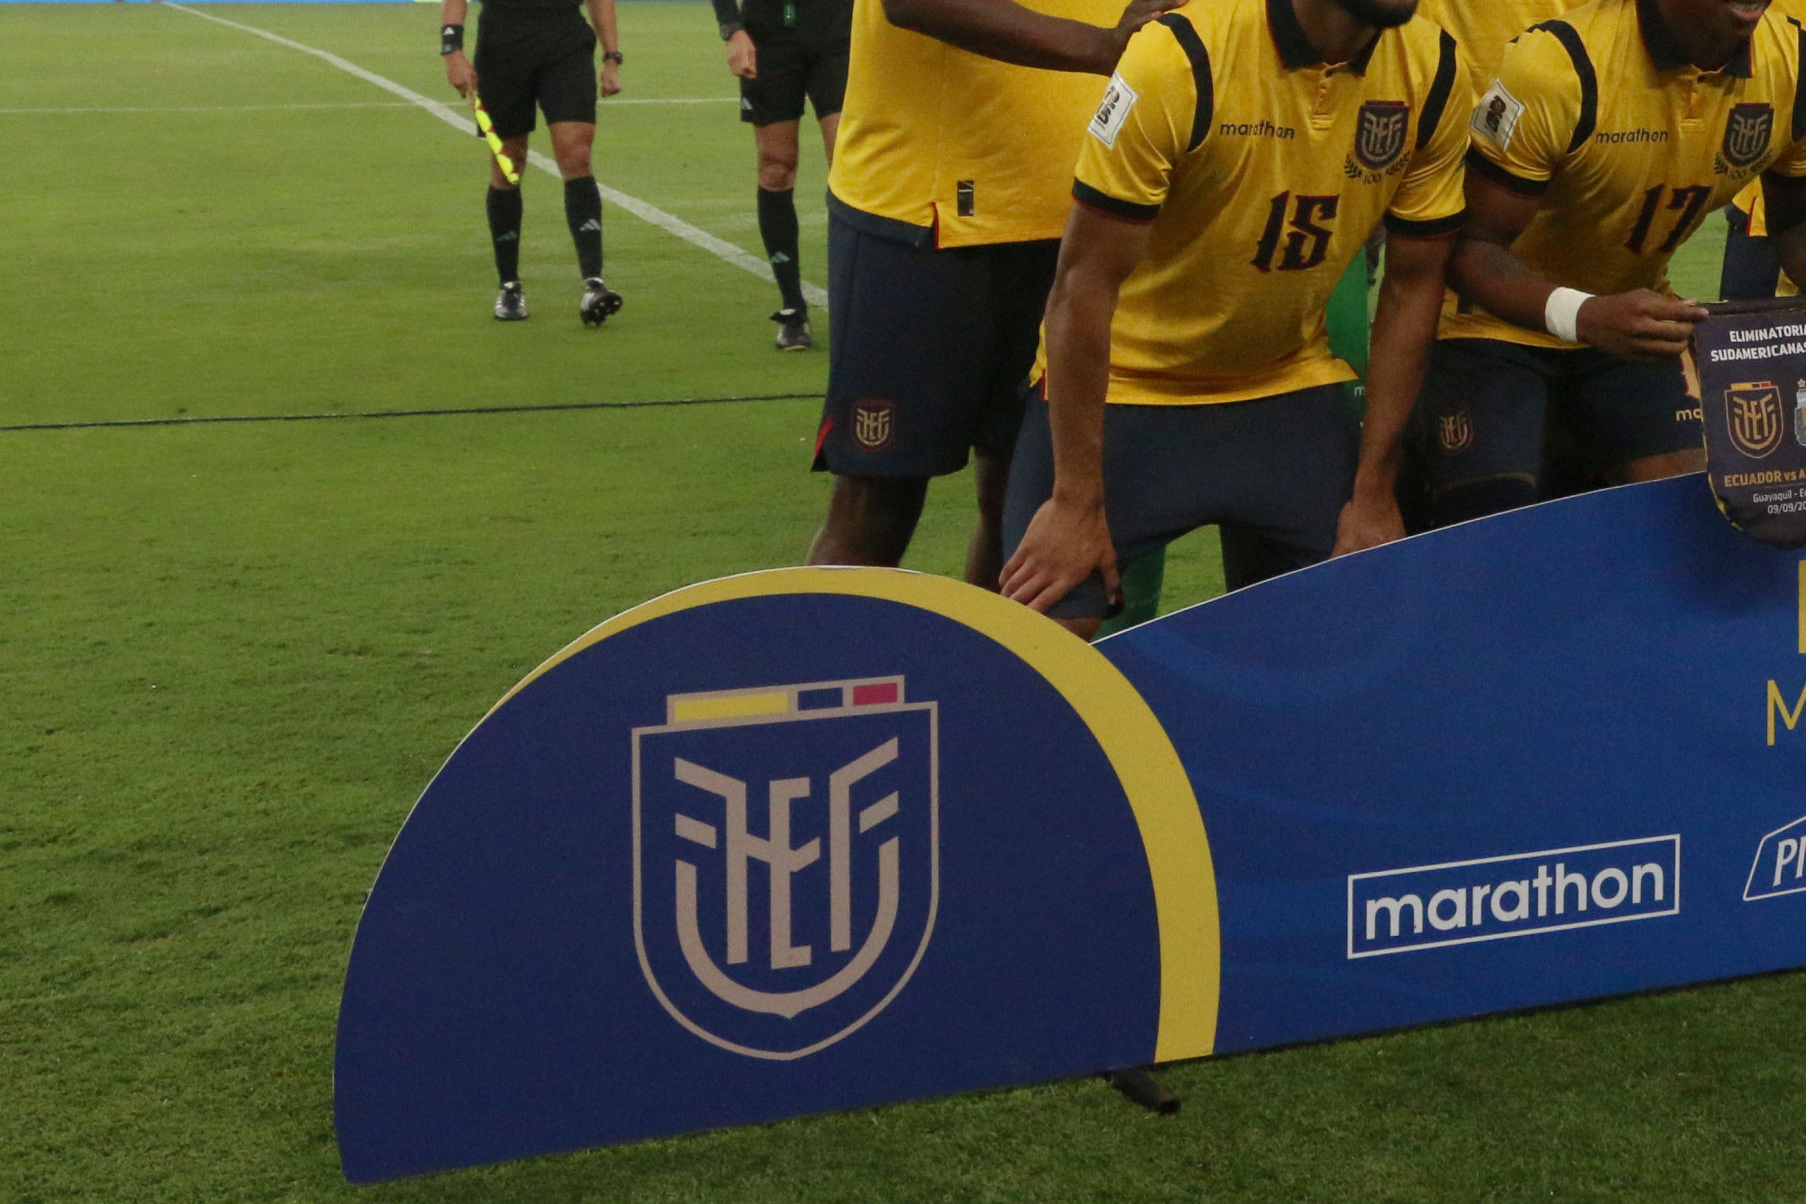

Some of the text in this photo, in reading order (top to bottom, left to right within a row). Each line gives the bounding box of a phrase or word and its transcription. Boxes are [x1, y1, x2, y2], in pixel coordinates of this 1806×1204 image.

[1219, 121, 1295, 140] marathon
[1596, 128, 1669, 144] marathon
[1625, 183, 1714, 255] 17
[1250, 190, 1341, 273] 15
[1724, 470, 1782, 487] ECUADOR
[1784, 471, 1796, 481] vs
[1753, 489, 1792, 504] Guayaquil
[1365, 856, 1667, 941] marathon
